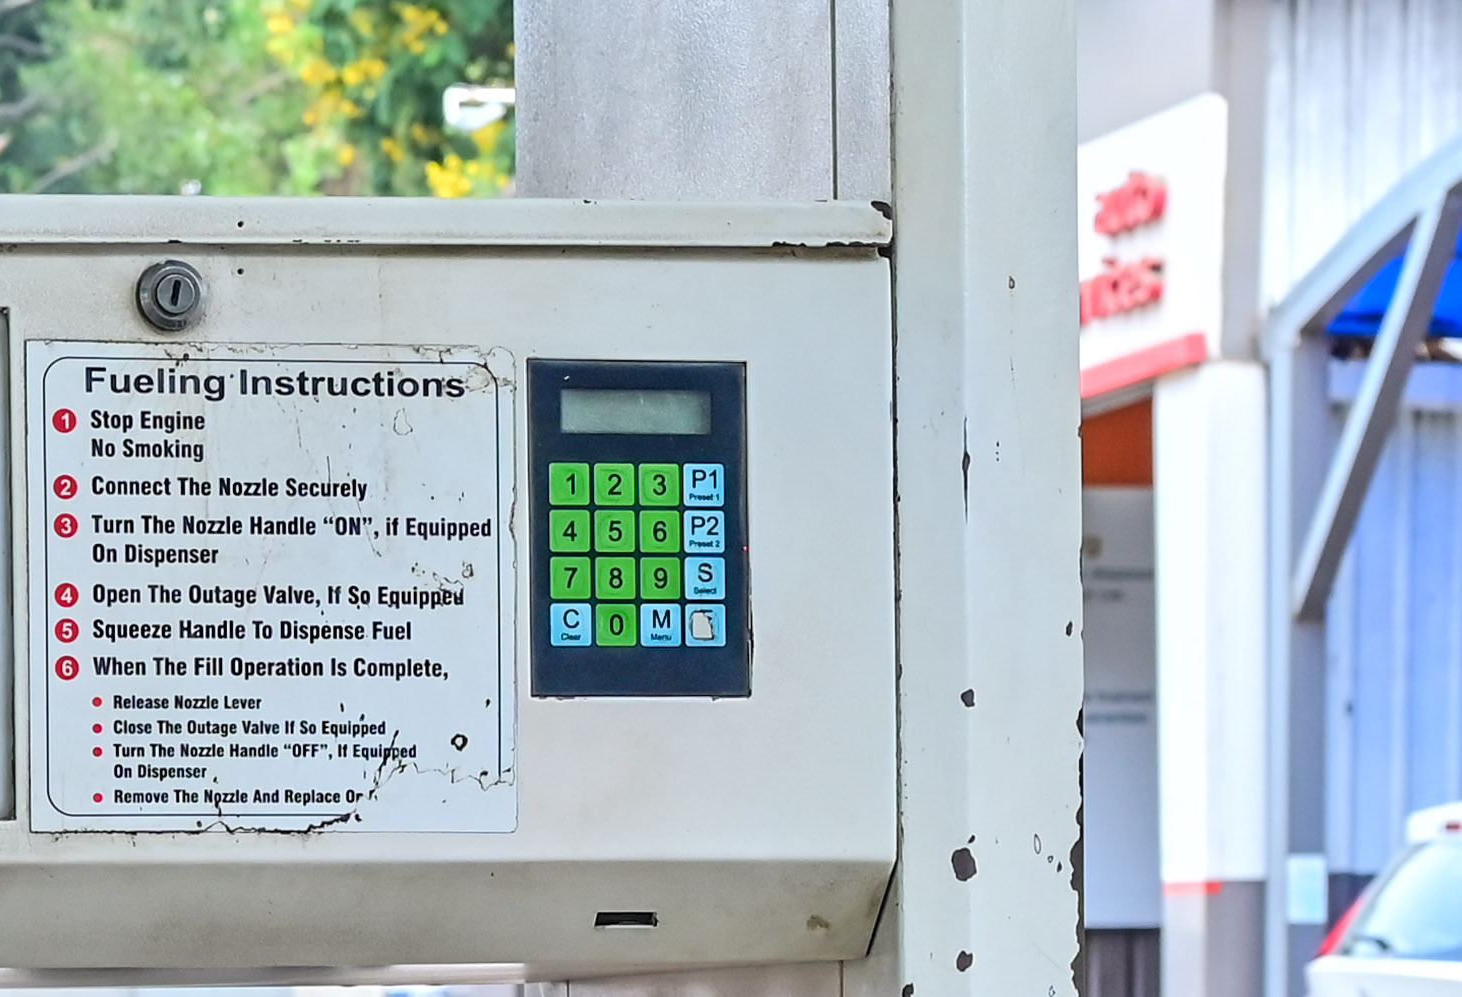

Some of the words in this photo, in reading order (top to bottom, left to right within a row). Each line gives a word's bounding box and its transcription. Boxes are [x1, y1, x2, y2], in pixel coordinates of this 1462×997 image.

[85, 366, 225, 402] Fueling
[240, 369, 465, 398] Instructions
[90, 409, 134, 434] Stop
[140, 410, 205, 434] Engine
[91, 438, 116, 458] No
[122, 438, 204, 463] Smoking
[91, 475, 172, 496] Connect
[176, 476, 212, 497] The
[218, 477, 279, 497] Nozzle
[285, 476, 368, 502] Securely
[566, 472, 576, 495] 1
[607, 473, 622, 496] 2
[652, 473, 667, 496] 3
[691, 469, 717, 490] P1
[91, 514, 135, 534] Turn
[140, 514, 175, 535] The
[182, 515, 243, 535] Nozzle
[249, 515, 316, 536] Handle
[386, 516, 399, 536] if
[405, 517, 492, 541] Equipped
[562, 520, 578, 542] 4
[608, 520, 623, 542] 5
[652, 520, 667, 543] 6
[691, 515, 719, 536] P2
[92, 543, 118, 563] On
[124, 543, 219, 568] Dispenser
[563, 567, 578, 589] 7
[608, 566, 624, 589] 8
[653, 567, 668, 590] 9
[697, 562, 714, 583] S
[93, 583, 141, 608] Open
[147, 584, 182, 604] The
[188, 584, 257, 609] Outage
[263, 585, 321, 608] Valve,
[327, 585, 342, 605] If
[348, 585, 371, 605] So
[377, 586, 464, 610] Equipped
[562, 608, 580, 629] C
[609, 613, 624, 636] 0
[652, 609, 671, 629] M
[92, 618, 172, 643] Squeeze
[179, 619, 246, 640] Handle
[251, 620, 273, 640] To
[280, 620, 365, 644] Dispense
[372, 621, 412, 641] Fuel
[92, 656, 147, 676] When
[152, 657, 187, 676] The
[194, 656, 223, 676] Fill
[230, 657, 324, 681] Operation
[330, 657, 347, 677] Is
[353, 657, 449, 682] Complete,
[113, 694, 169, 710] Release
[174, 695, 219, 710] Nozzle
[223, 695, 262, 710] Lever
[113, 719, 152, 735] Close
[156, 719, 183, 735] The
[187, 719, 238, 738] Outage
[241, 720, 280, 735] Valve
[284, 720, 295, 735] If
[299, 720, 317, 735] So
[321, 720, 386, 738] Equipped
[112, 743, 145, 758] Turn
[149, 743, 175, 758] The
[180, 743, 225, 758] Nozzle
[229, 743, 279, 758] Handle
[337, 743, 348, 758] If
[351, 744, 418, 763] Equipped
[113, 763, 132, 779] On
[137, 764, 207, 782] Dispenser
[114, 789, 169, 804] Remove
[173, 789, 199, 804] The
[202, 788, 248, 805] Nozzle
[252, 789, 280, 804] And
[284, 789, 341, 807] Replace
